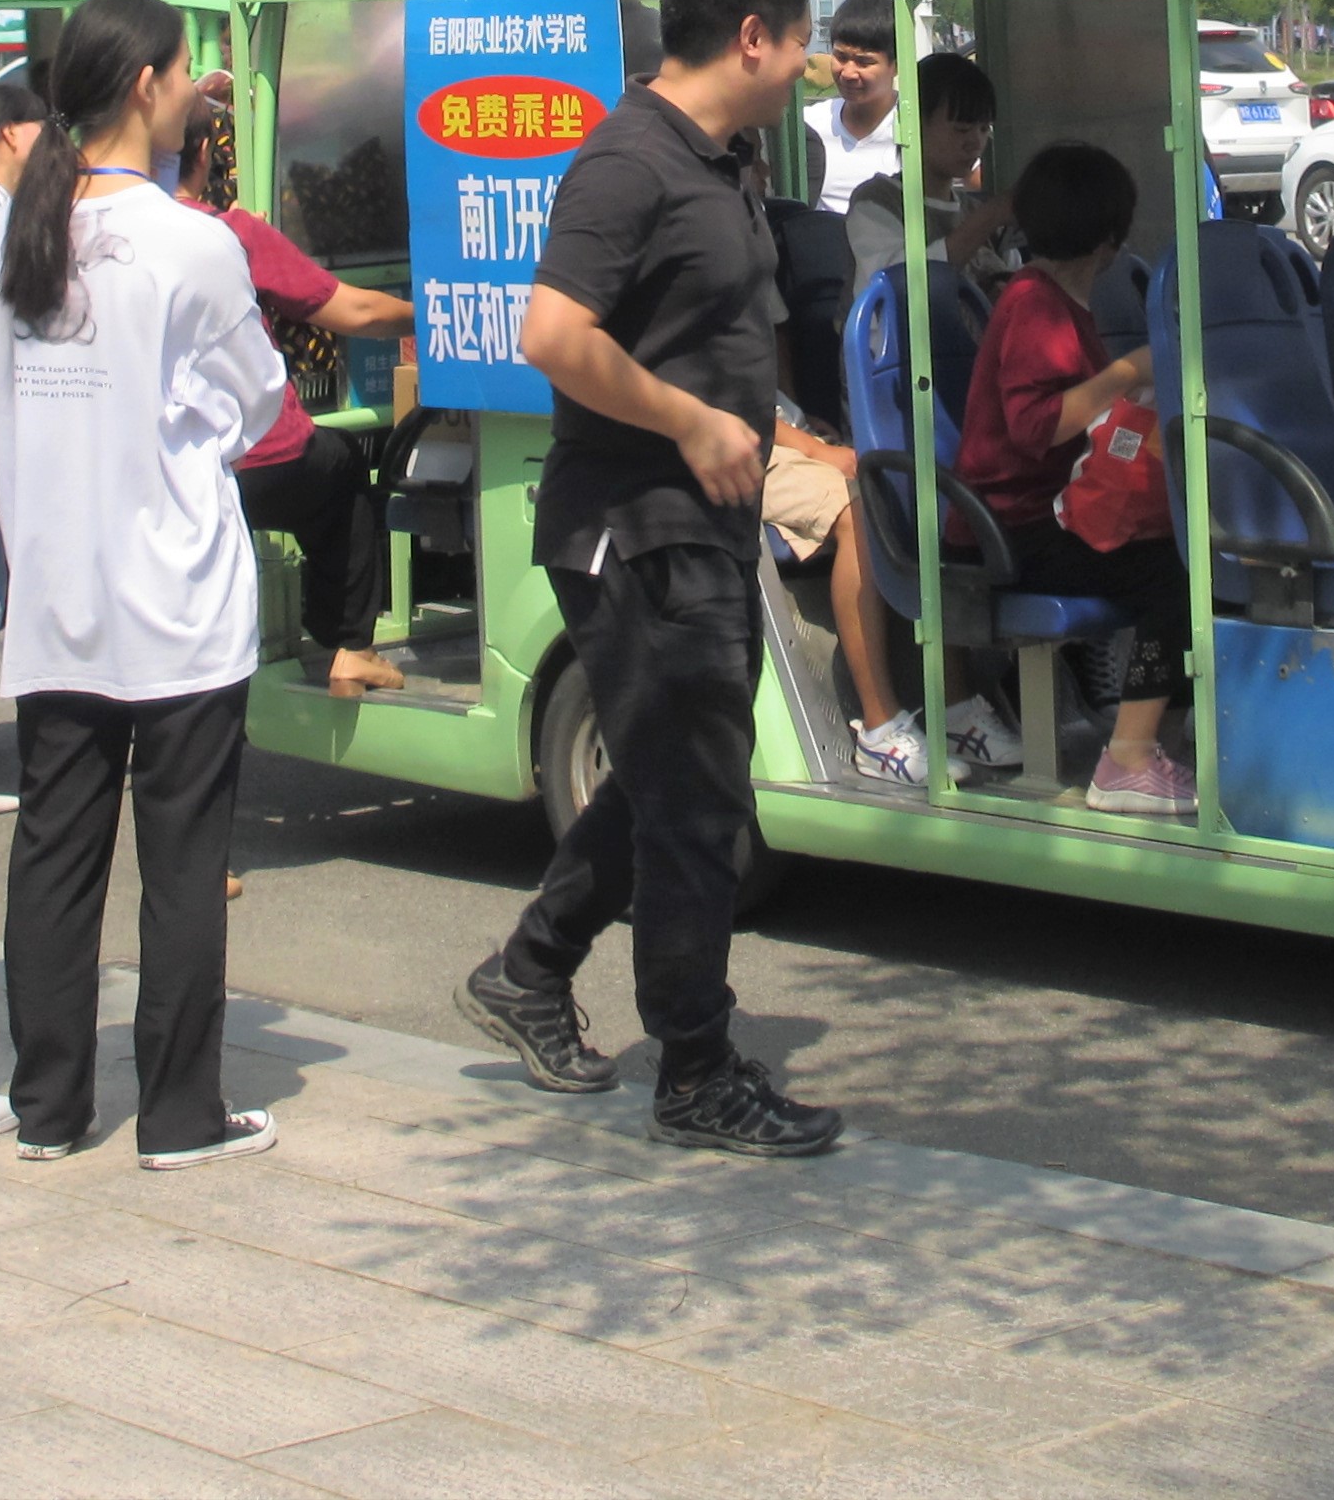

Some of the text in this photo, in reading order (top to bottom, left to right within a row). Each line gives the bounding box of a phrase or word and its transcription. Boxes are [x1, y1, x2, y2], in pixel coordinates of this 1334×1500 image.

[428, 13, 588, 56] 信阳职业技术学院
[441, 94, 585, 139] 免费乘坐
